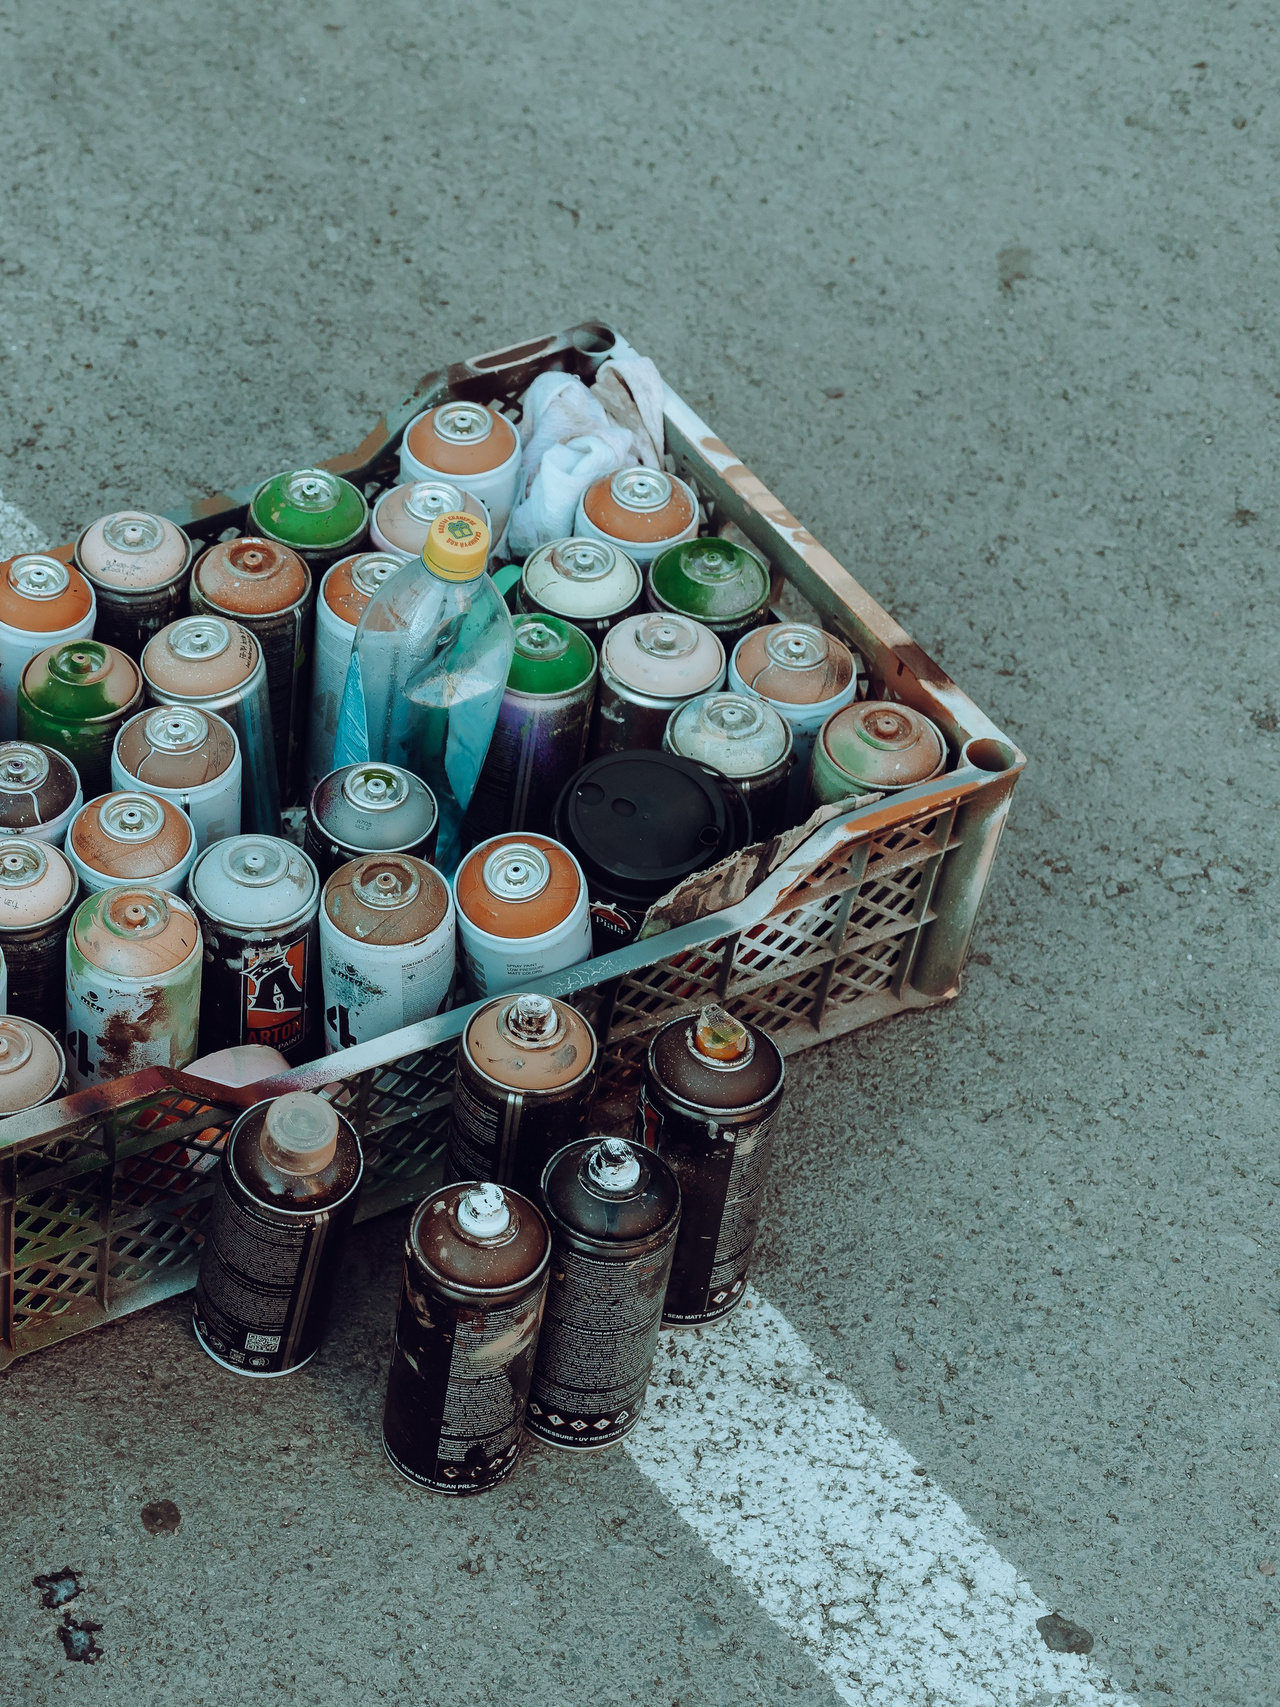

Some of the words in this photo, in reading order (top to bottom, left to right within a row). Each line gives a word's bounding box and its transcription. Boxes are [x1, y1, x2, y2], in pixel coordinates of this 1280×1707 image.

[4, 899, 19, 909] WELL
[401, 959, 424, 969] MONTANA
[80, 995, 105, 1013] mtn
[246, 1017, 303, 1046] ARTON
[278, 1035, 301, 1050] PAINT
[706, 1308, 724, 1317] MEAN
[539, 1425, 574, 1441] PRESSURE
[589, 1428, 622, 1441] RESISTANT
[401, 1463, 415, 1475] SEMI
[415, 1473, 432, 1484] MATT
